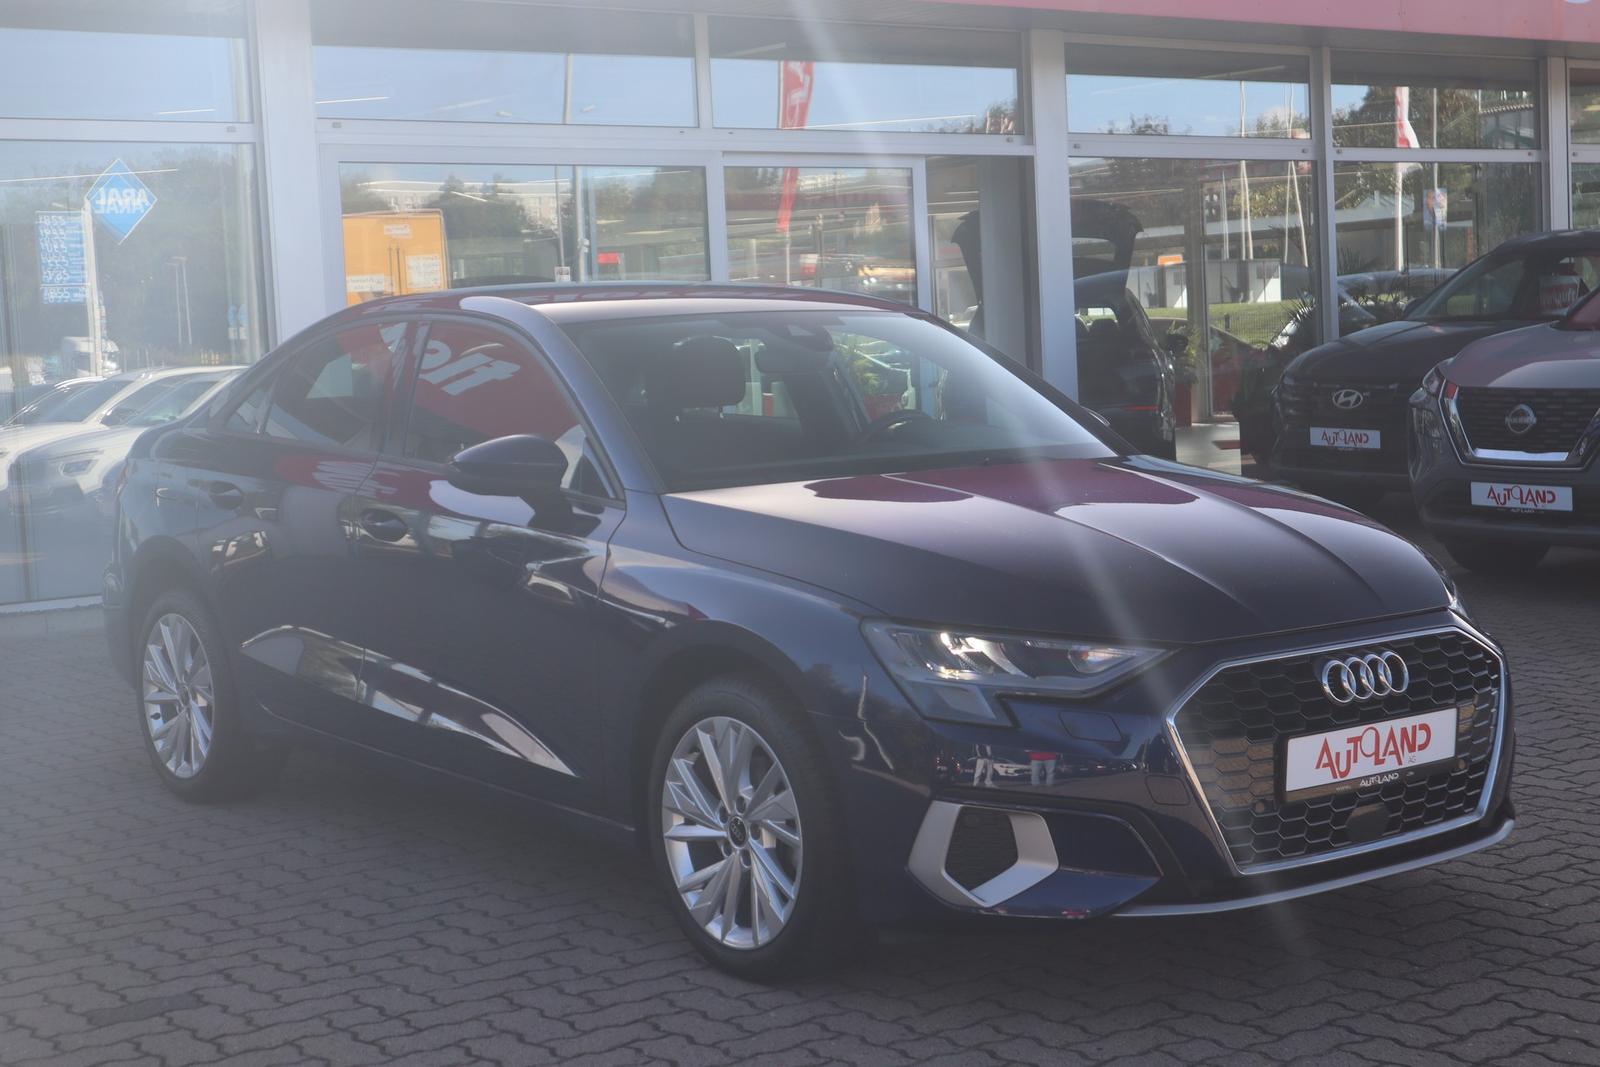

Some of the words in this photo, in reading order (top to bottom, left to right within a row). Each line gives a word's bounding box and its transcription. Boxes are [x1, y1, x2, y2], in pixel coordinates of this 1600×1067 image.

[1322, 429, 1370, 447] AUTOLAND
[1487, 485, 1556, 508] AUTOLAND
[1315, 723, 1432, 779] AUTOLAND
[1360, 772, 1400, 787] AUTOLAND
